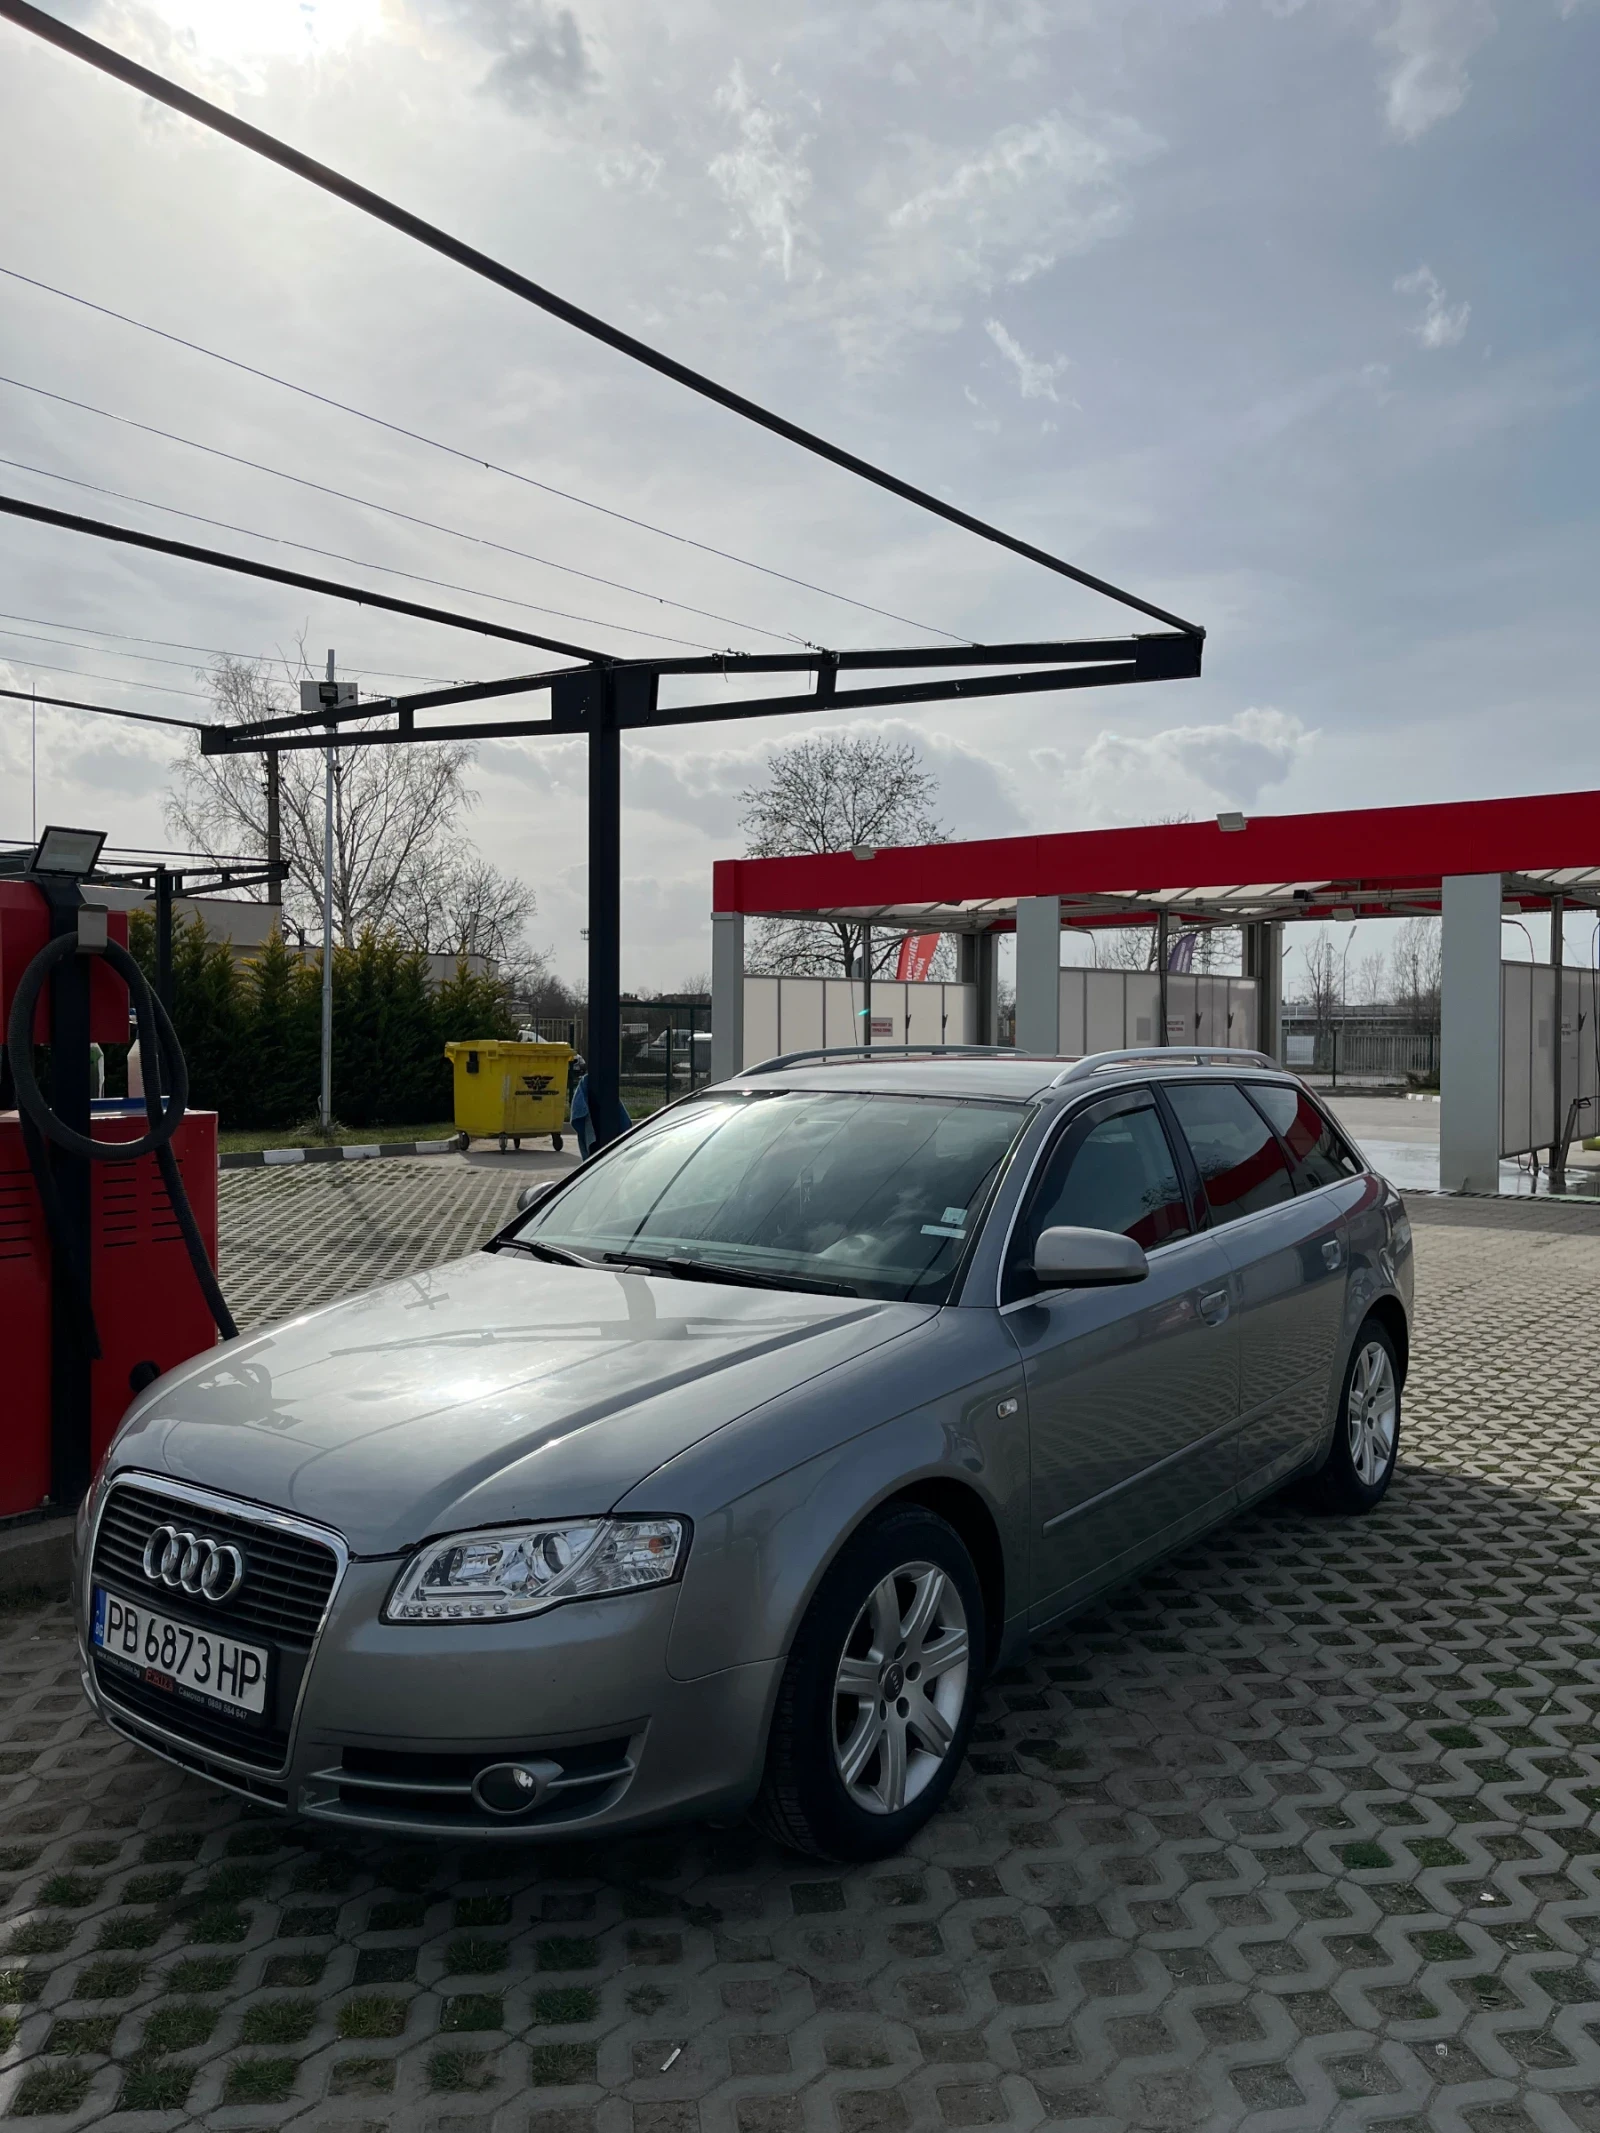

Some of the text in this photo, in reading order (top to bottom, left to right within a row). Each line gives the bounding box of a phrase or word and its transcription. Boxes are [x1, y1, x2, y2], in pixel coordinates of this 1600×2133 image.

[95, 1622, 104, 1638] BG
[107, 1600, 261, 1698] PB 6873 HP
